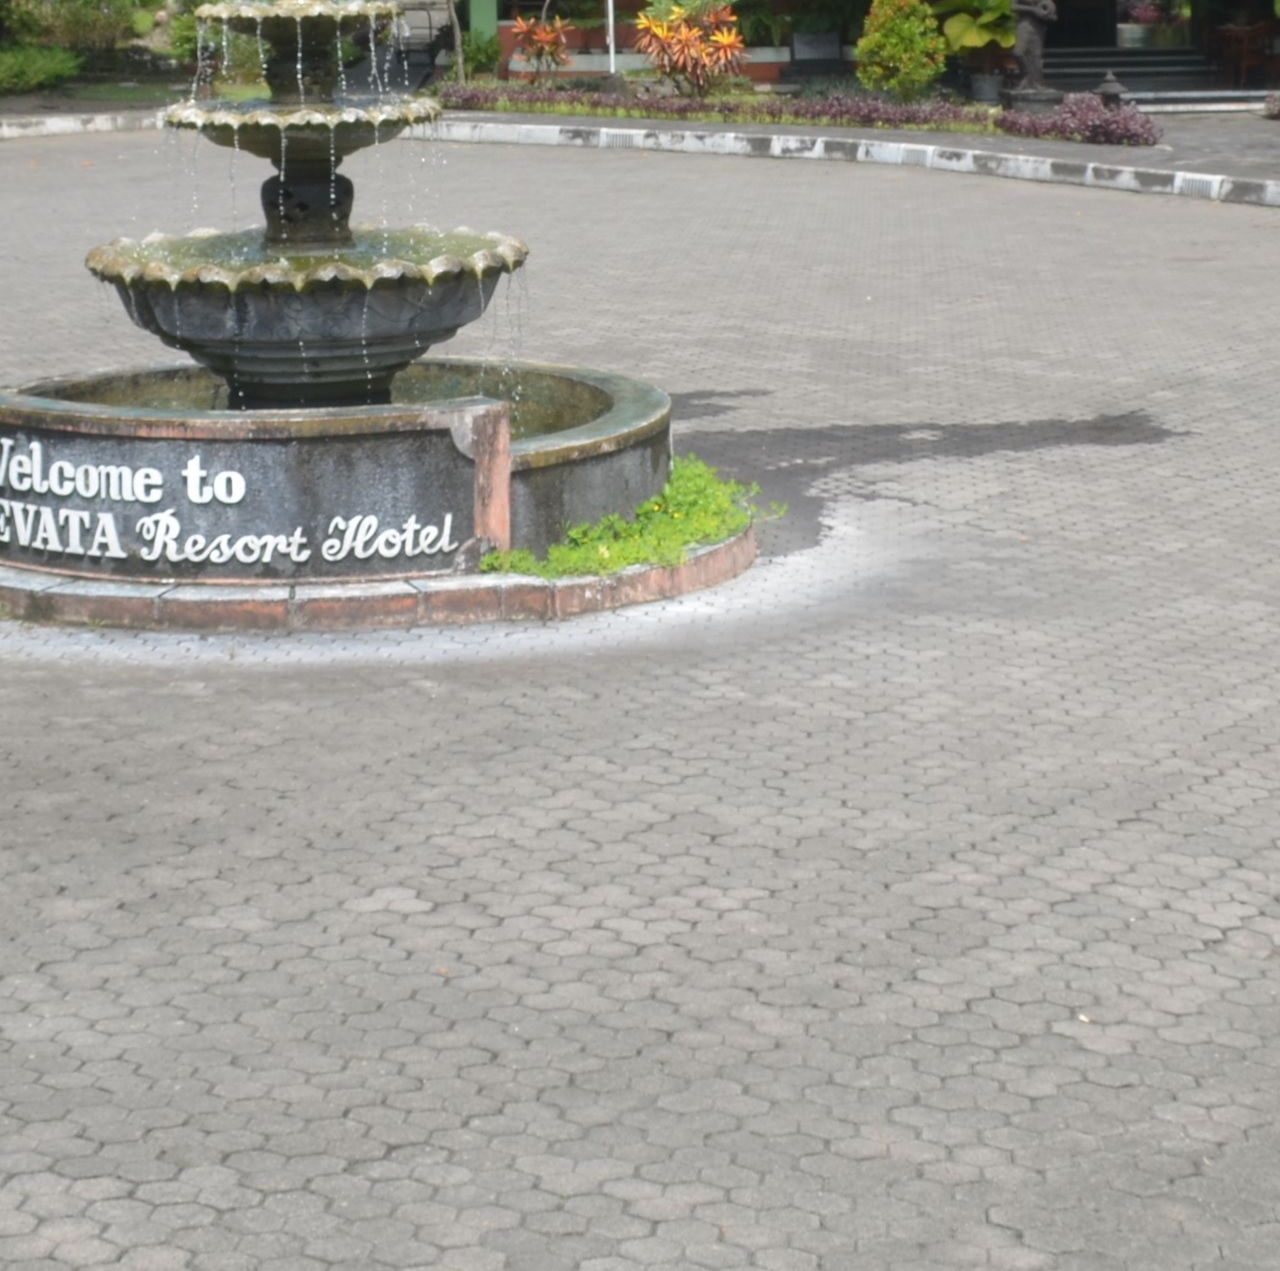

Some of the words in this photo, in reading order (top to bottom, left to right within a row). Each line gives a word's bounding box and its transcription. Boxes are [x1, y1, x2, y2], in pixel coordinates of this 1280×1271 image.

[182, 455, 246, 504] to
[135, 508, 311, 563] Resort
[322, 513, 458, 562] Hotel
